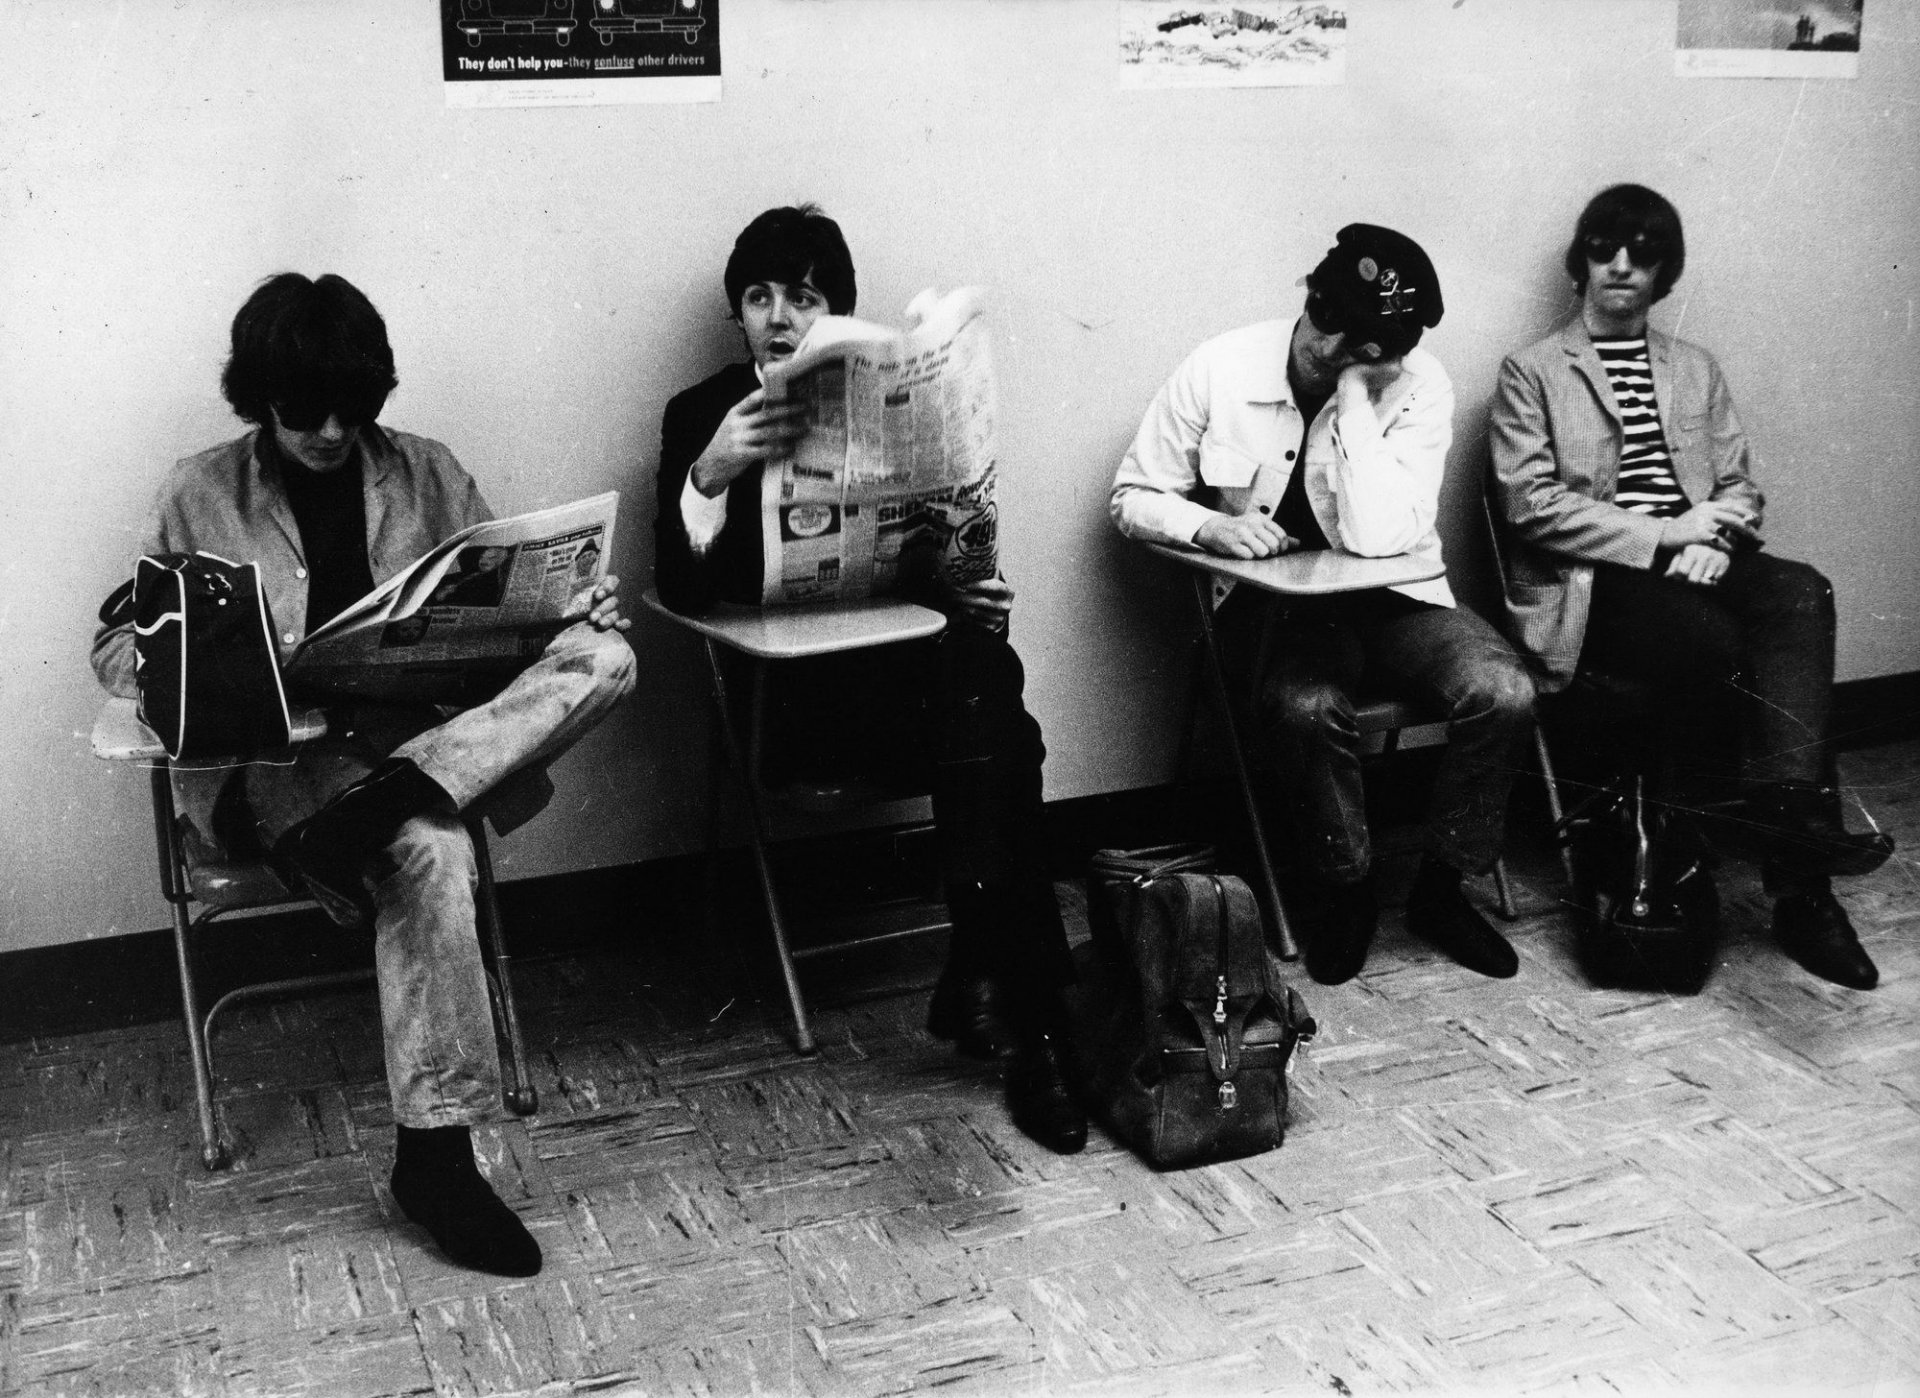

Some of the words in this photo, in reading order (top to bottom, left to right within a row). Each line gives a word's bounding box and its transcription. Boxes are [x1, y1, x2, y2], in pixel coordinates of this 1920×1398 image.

[458, 56, 485, 72] They
[487, 57, 515, 72] don't
[518, 56, 541, 71] help
[594, 55, 635, 70] confuse
[637, 54, 664, 66] other
[667, 53, 705, 65] drivers
